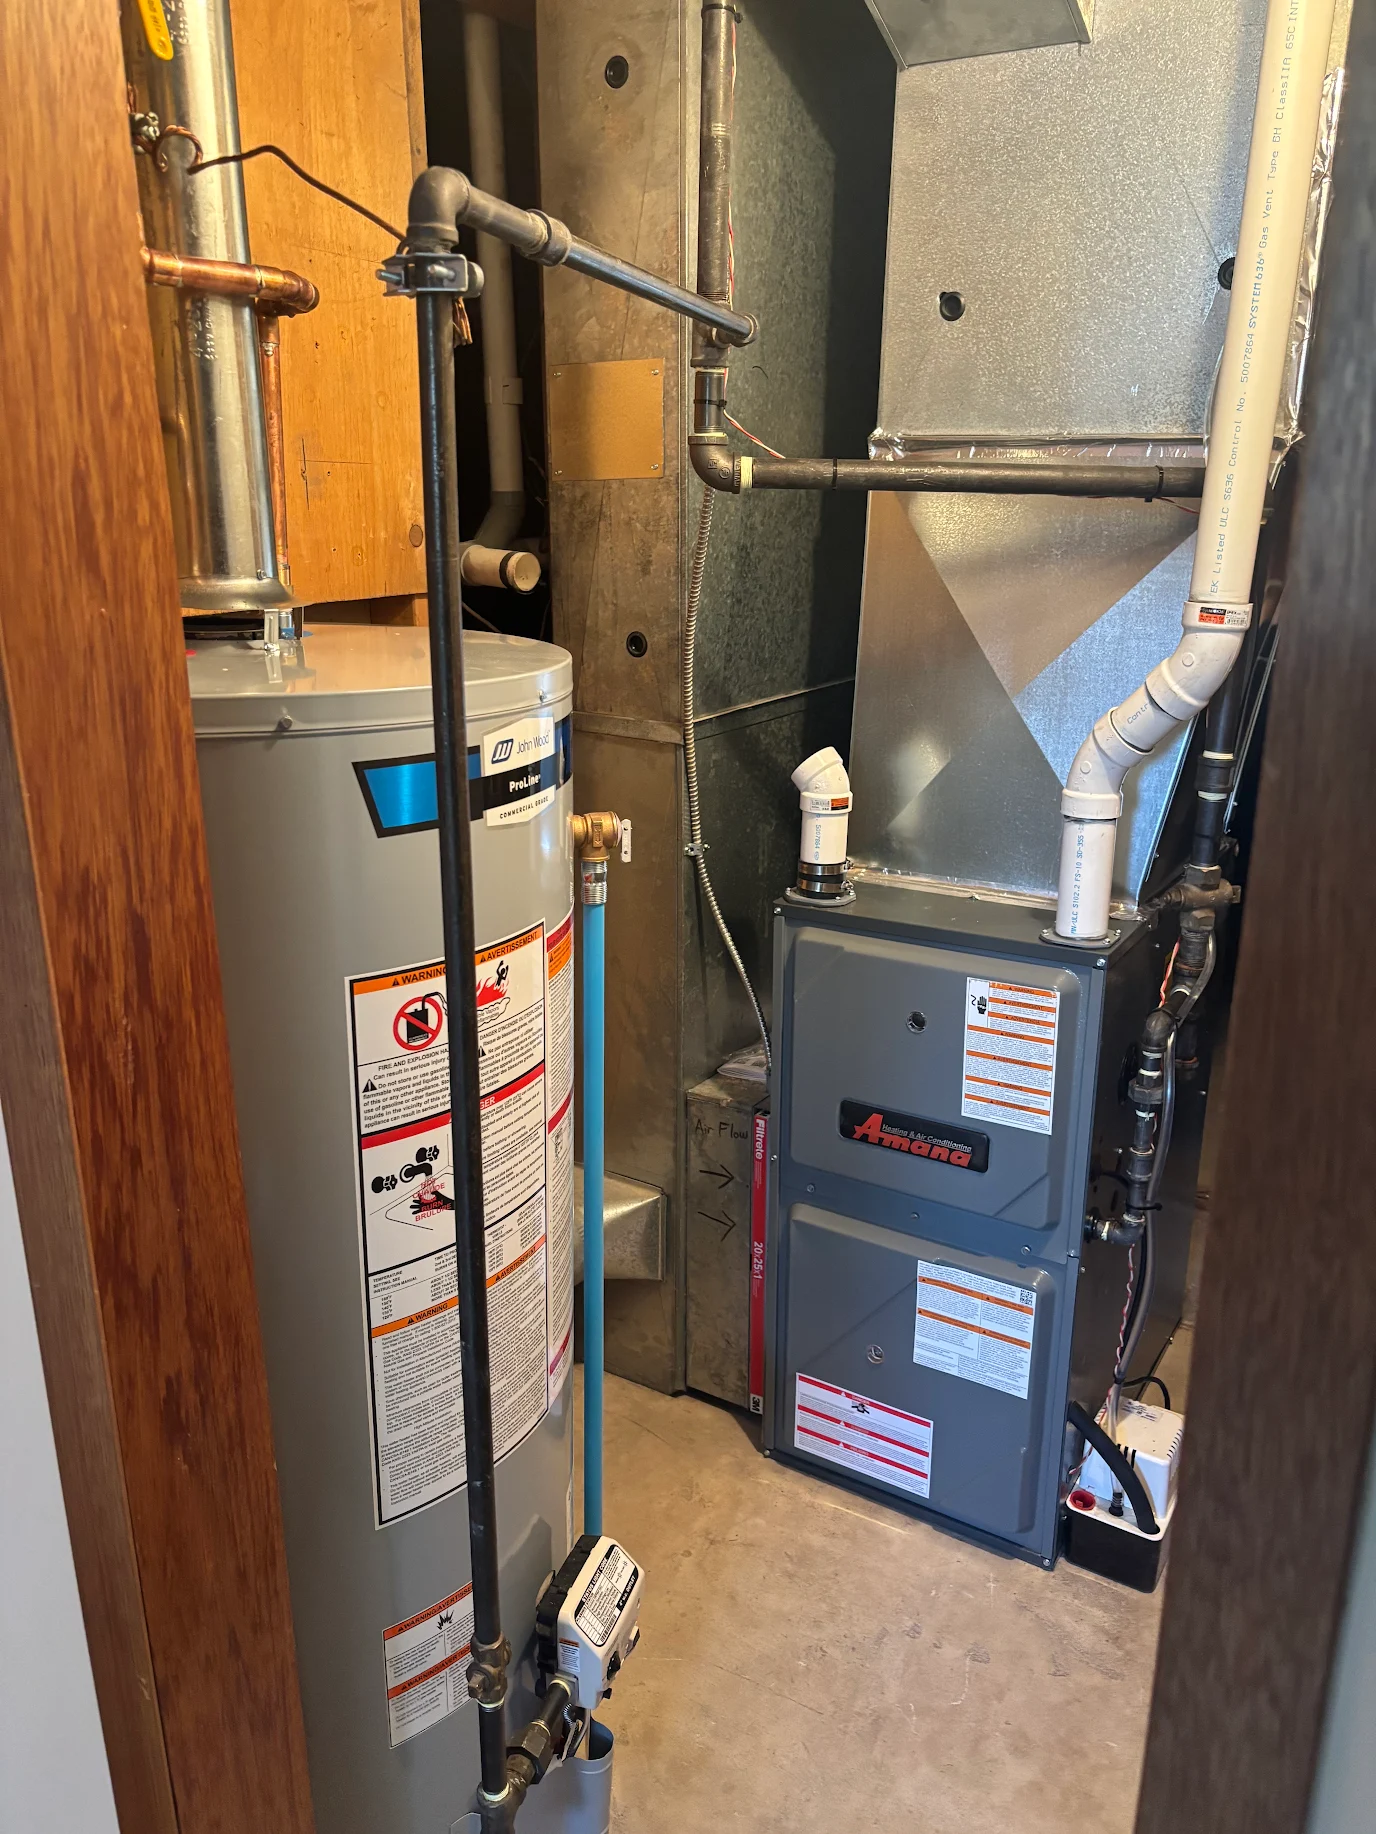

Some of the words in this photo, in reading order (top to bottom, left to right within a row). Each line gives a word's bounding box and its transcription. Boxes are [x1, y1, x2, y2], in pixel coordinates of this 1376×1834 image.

[1267, 151, 1279, 180] Type
[1263, 190, 1274, 218] Vent
[1259, 226, 1269, 248] Gas
[1241, 334, 1254, 383] 5007864
[1236, 392, 1247, 412] No.
[1229, 421, 1242, 467] Control
[1224, 474, 1234, 501] S636
[1220, 507, 1229, 528] ULC
[1212, 533, 1226, 574] Listed
[1126, 704, 1148, 725] Contr
[516, 740, 533, 754] John
[533, 734, 549, 749] Wood
[500, 804, 534, 819] COMMERCIAL
[535, 796, 549, 807] GRADE
[1073, 884, 1081, 908] S102.2
[487, 931, 537, 960] AVERTISSEMENT
[695, 1118, 714, 1134] Air
[719, 1122, 748, 1139] Flow
[755, 1119, 765, 1159] Filtrete
[852, 1113, 972, 1167] Amana
[882, 1124, 908, 1137] Heating
[916, 1132, 926, 1140] Air
[928, 1135, 972, 1153] Conditioning
[421, 1200, 444, 1212] BURN
[753, 1241, 763, 1279] 20x25x1
[416, 1303, 448, 1320] WARNING
[751, 1397, 761, 1413] 3M
